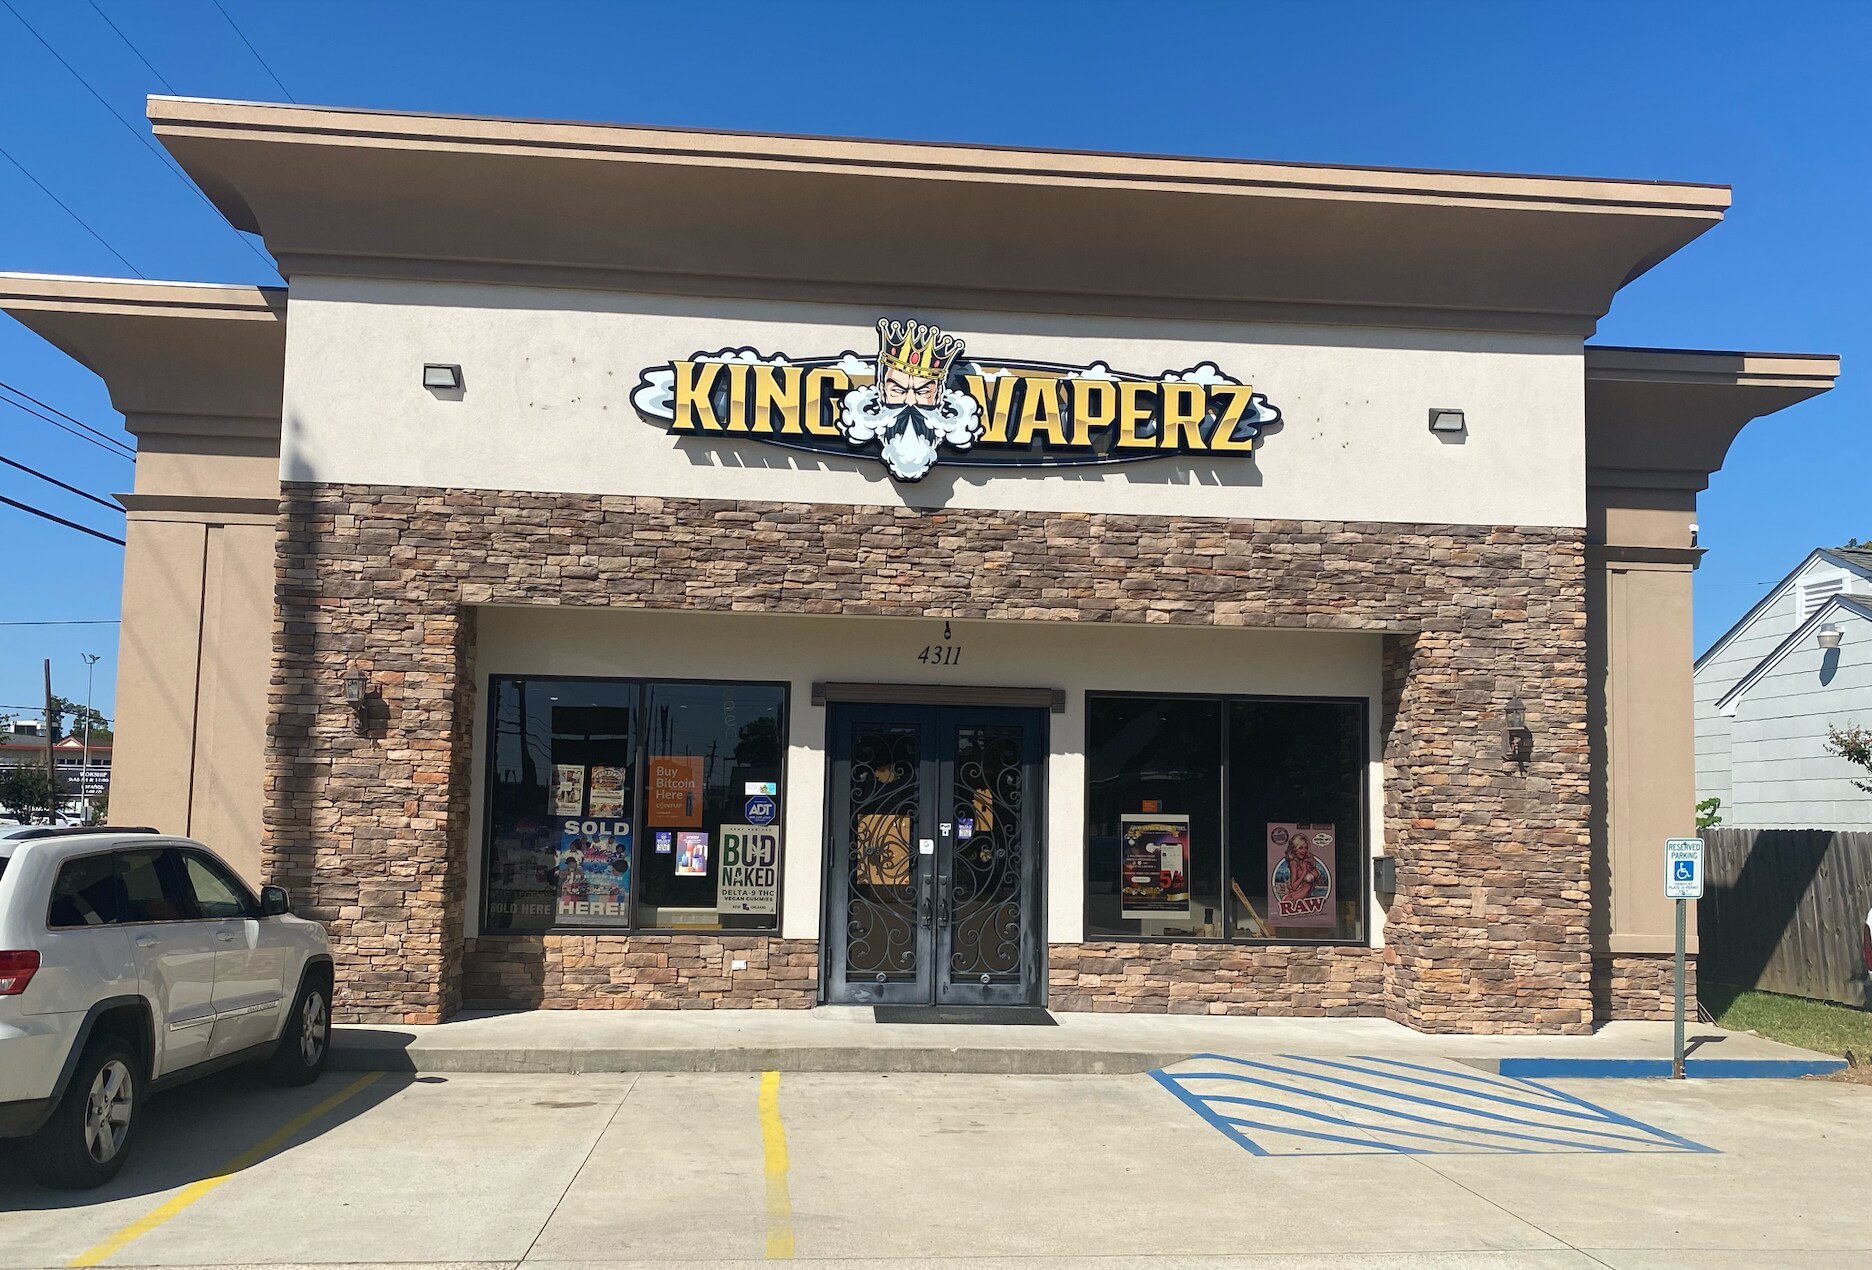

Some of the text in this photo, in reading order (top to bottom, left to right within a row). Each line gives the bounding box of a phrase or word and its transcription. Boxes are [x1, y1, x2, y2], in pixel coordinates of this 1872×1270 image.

[672, 361, 1253, 451] KING VAPERZ
[918, 645, 962, 665] 4311
[656, 766, 678, 778] Buy
[656, 778, 695, 788] Bitcoin
[655, 790, 683, 800] Here
[748, 803, 773, 815] ADT
[564, 820, 630, 835] SOLD
[723, 834, 776, 867] BUD
[1669, 843, 1700, 851] RESERVED
[722, 867, 775, 887] NAKED
[490, 902, 552, 915] SOLD HERE
[558, 900, 625, 916] HERE!
[1279, 897, 1325, 916] RAW
